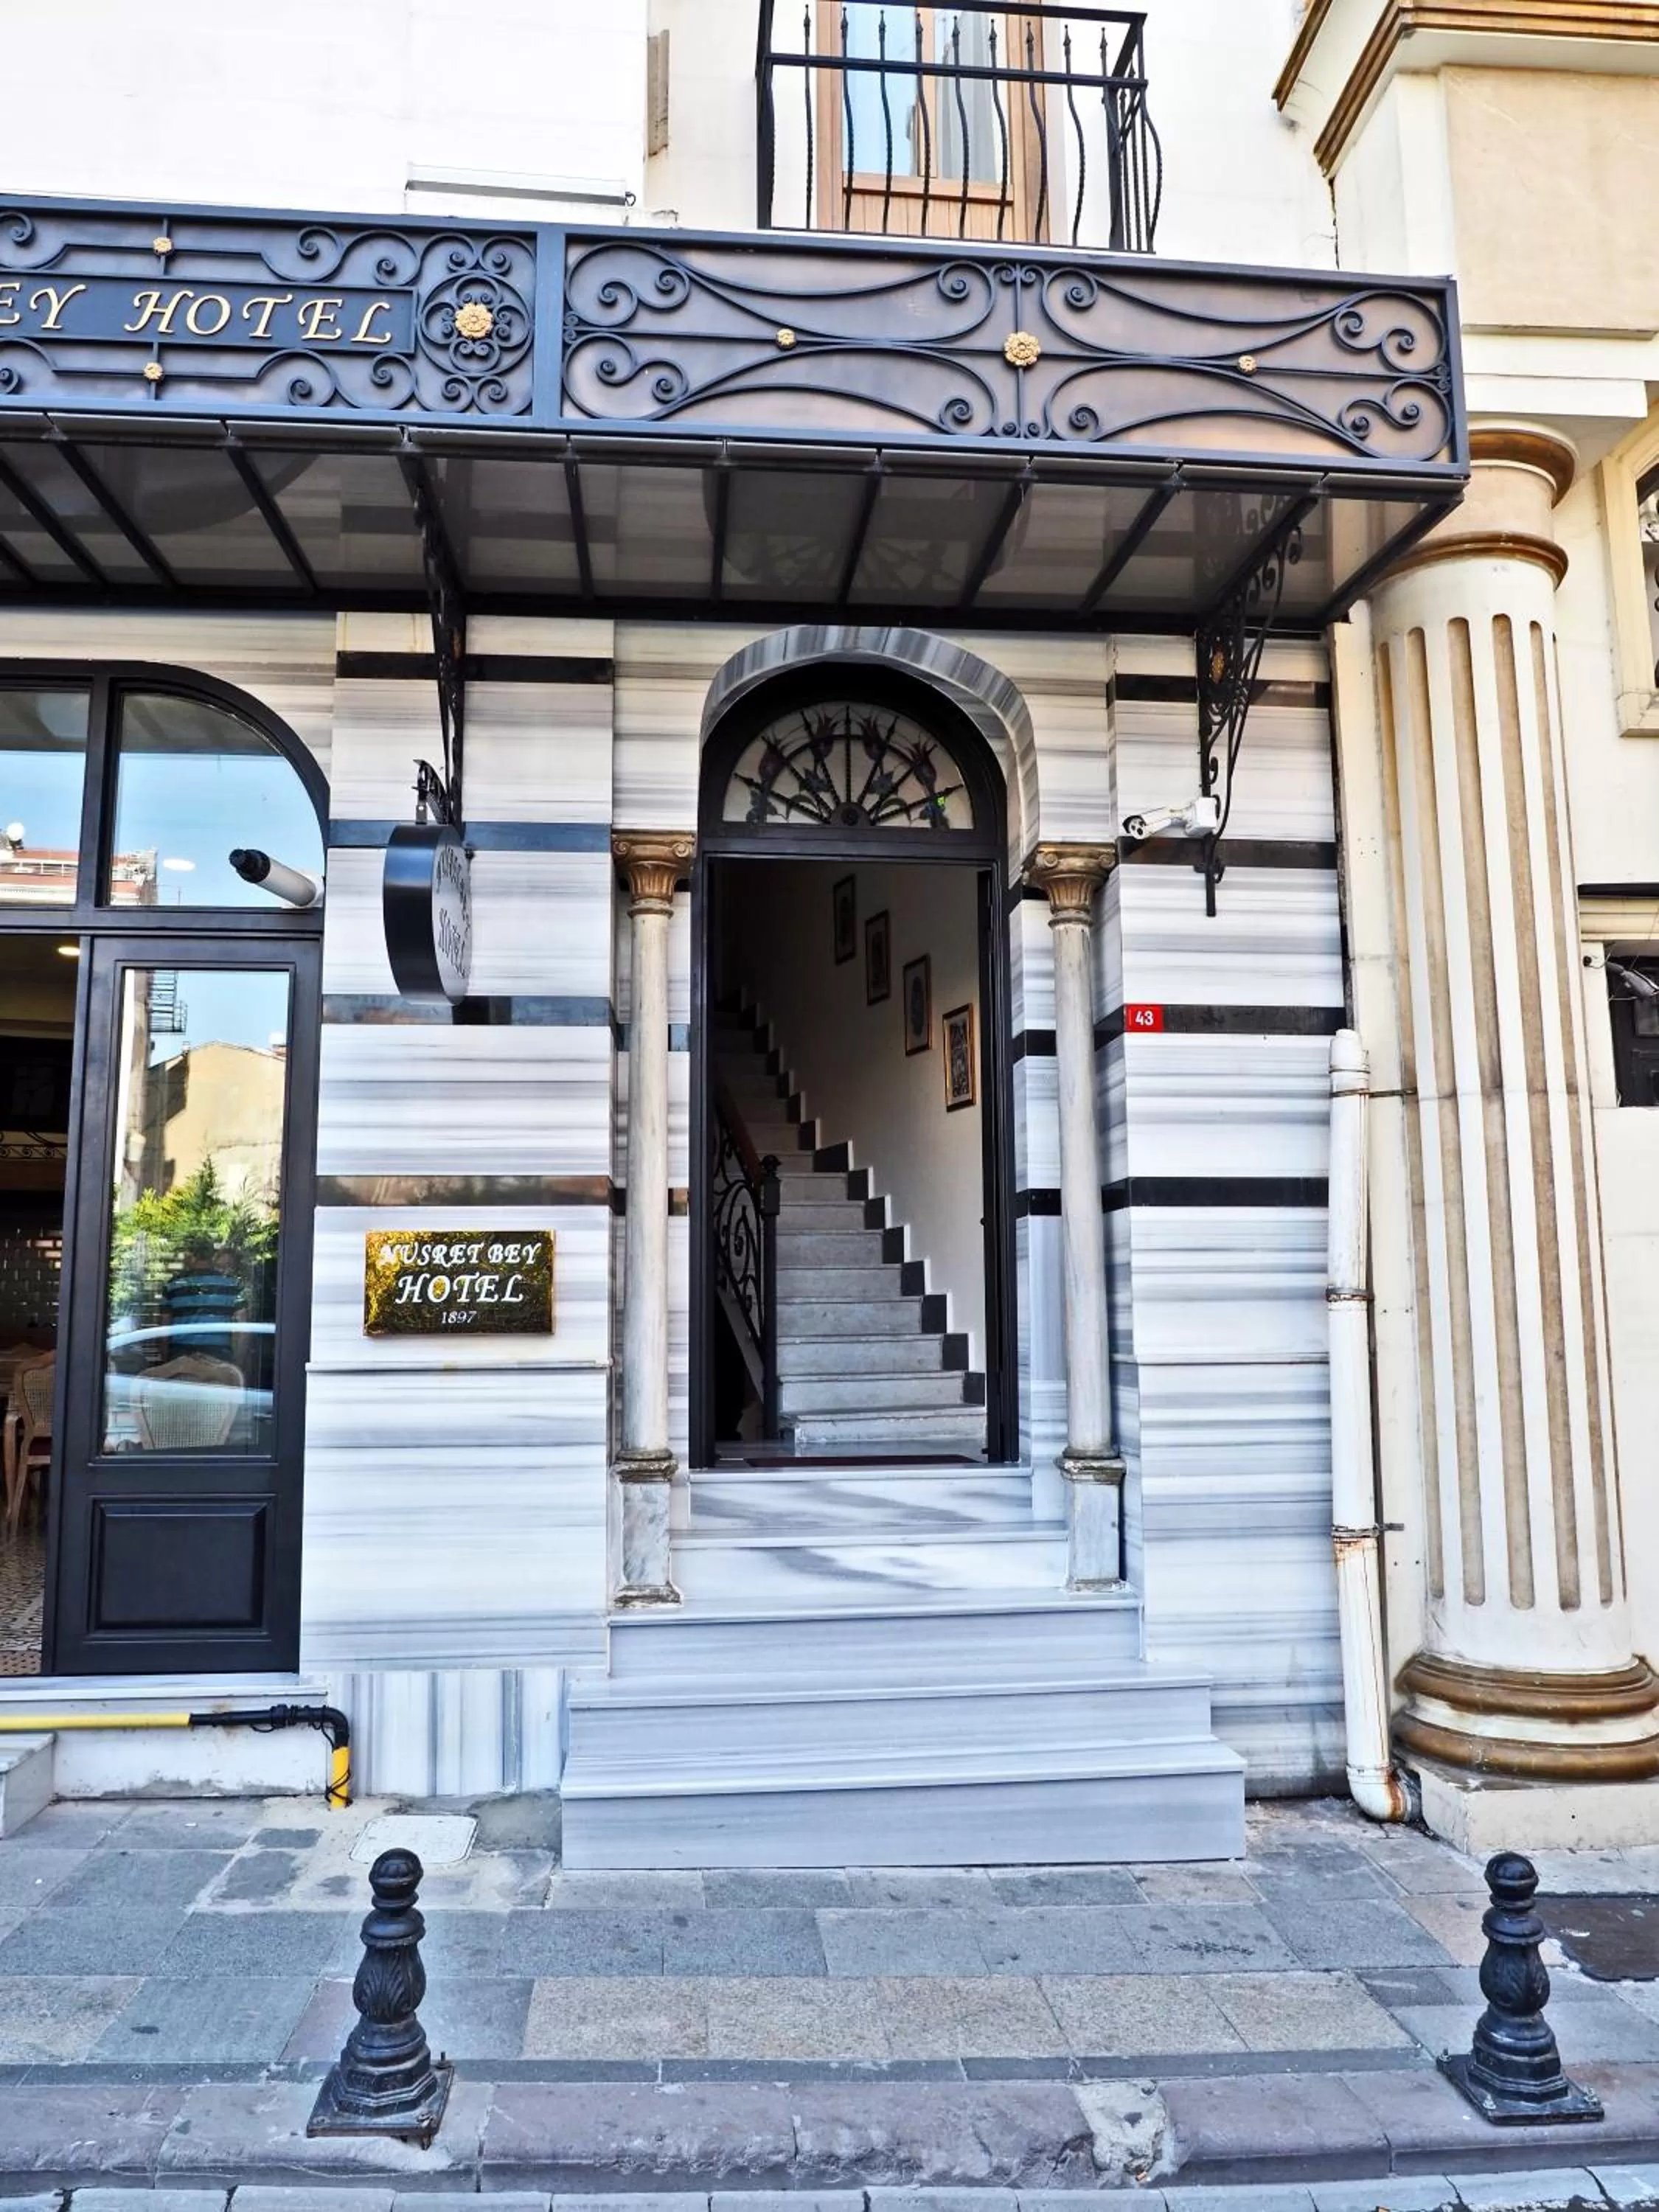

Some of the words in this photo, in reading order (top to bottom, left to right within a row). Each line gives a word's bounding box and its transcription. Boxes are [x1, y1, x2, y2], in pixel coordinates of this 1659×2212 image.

[124, 291, 392, 344] HOTEL
[1135, 1009, 1154, 1026] 43
[487, 1242, 541, 1264] BEY
[395, 1273, 524, 1304] HOTEL
[442, 1310, 477, 1324] 1897
